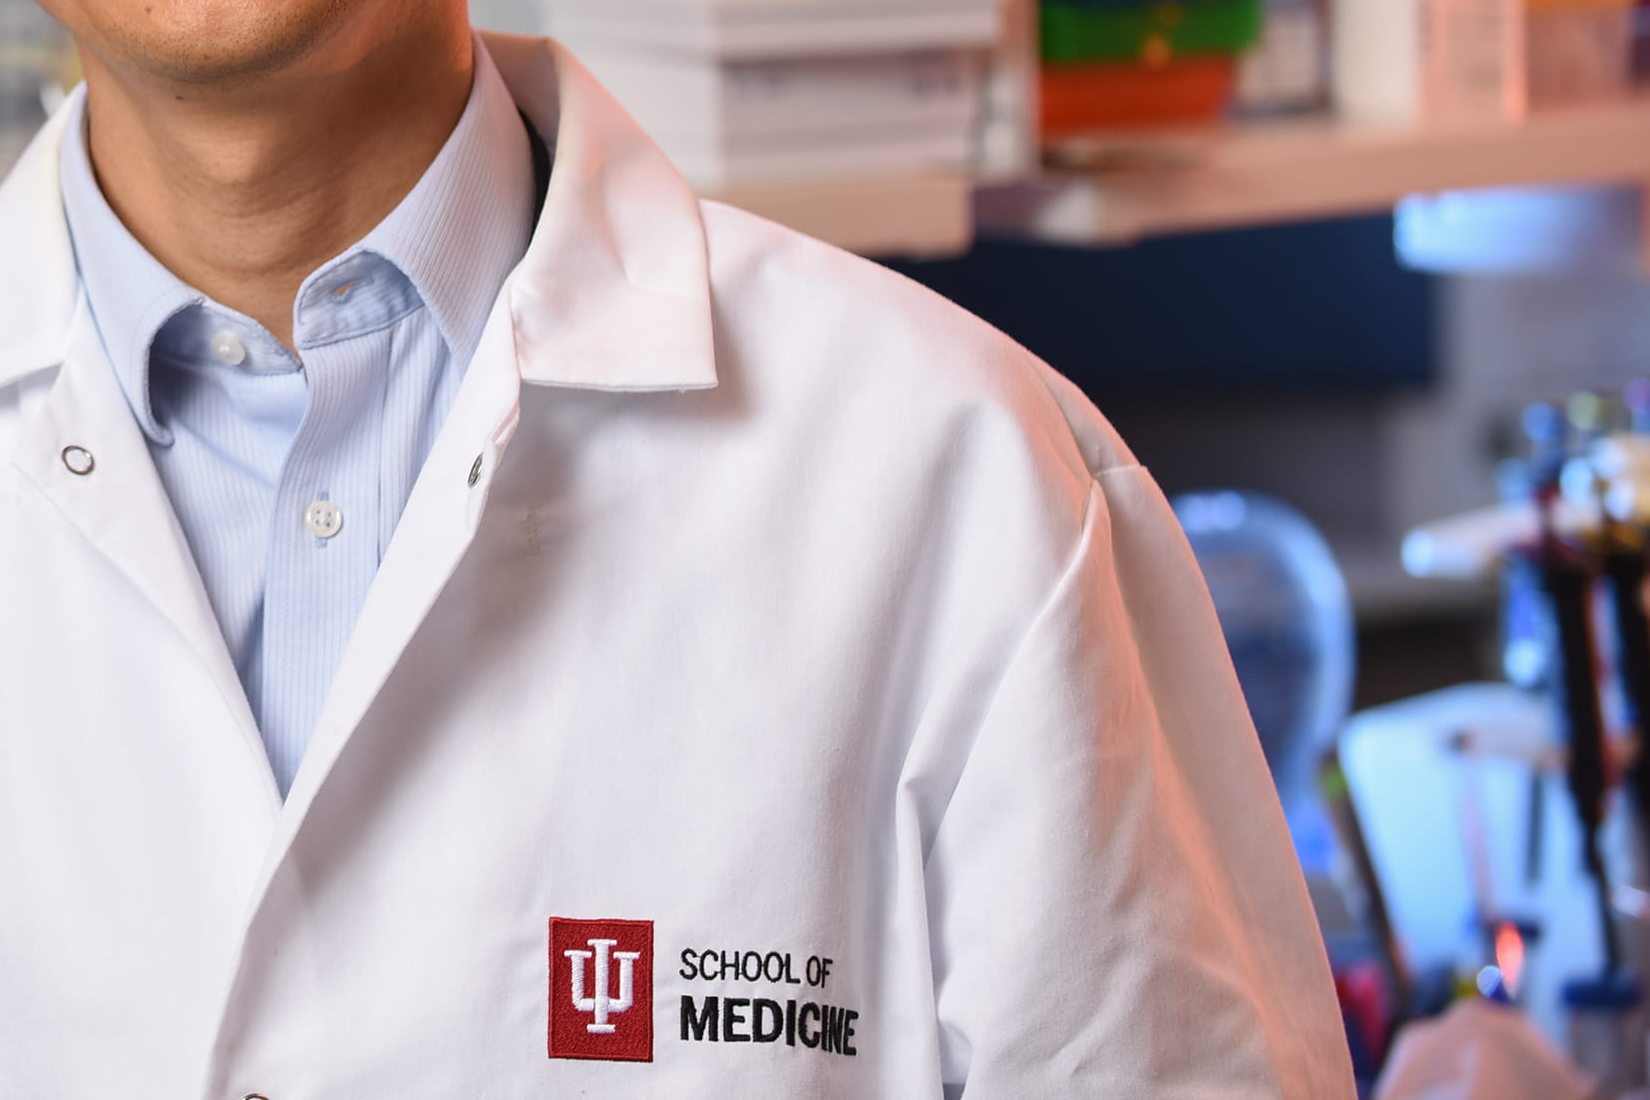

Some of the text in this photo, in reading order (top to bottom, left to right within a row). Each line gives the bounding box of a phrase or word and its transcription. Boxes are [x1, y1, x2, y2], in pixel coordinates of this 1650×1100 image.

[678, 947, 834, 989] SCHOOL OF
[680, 994, 860, 1057] MEDICINE
